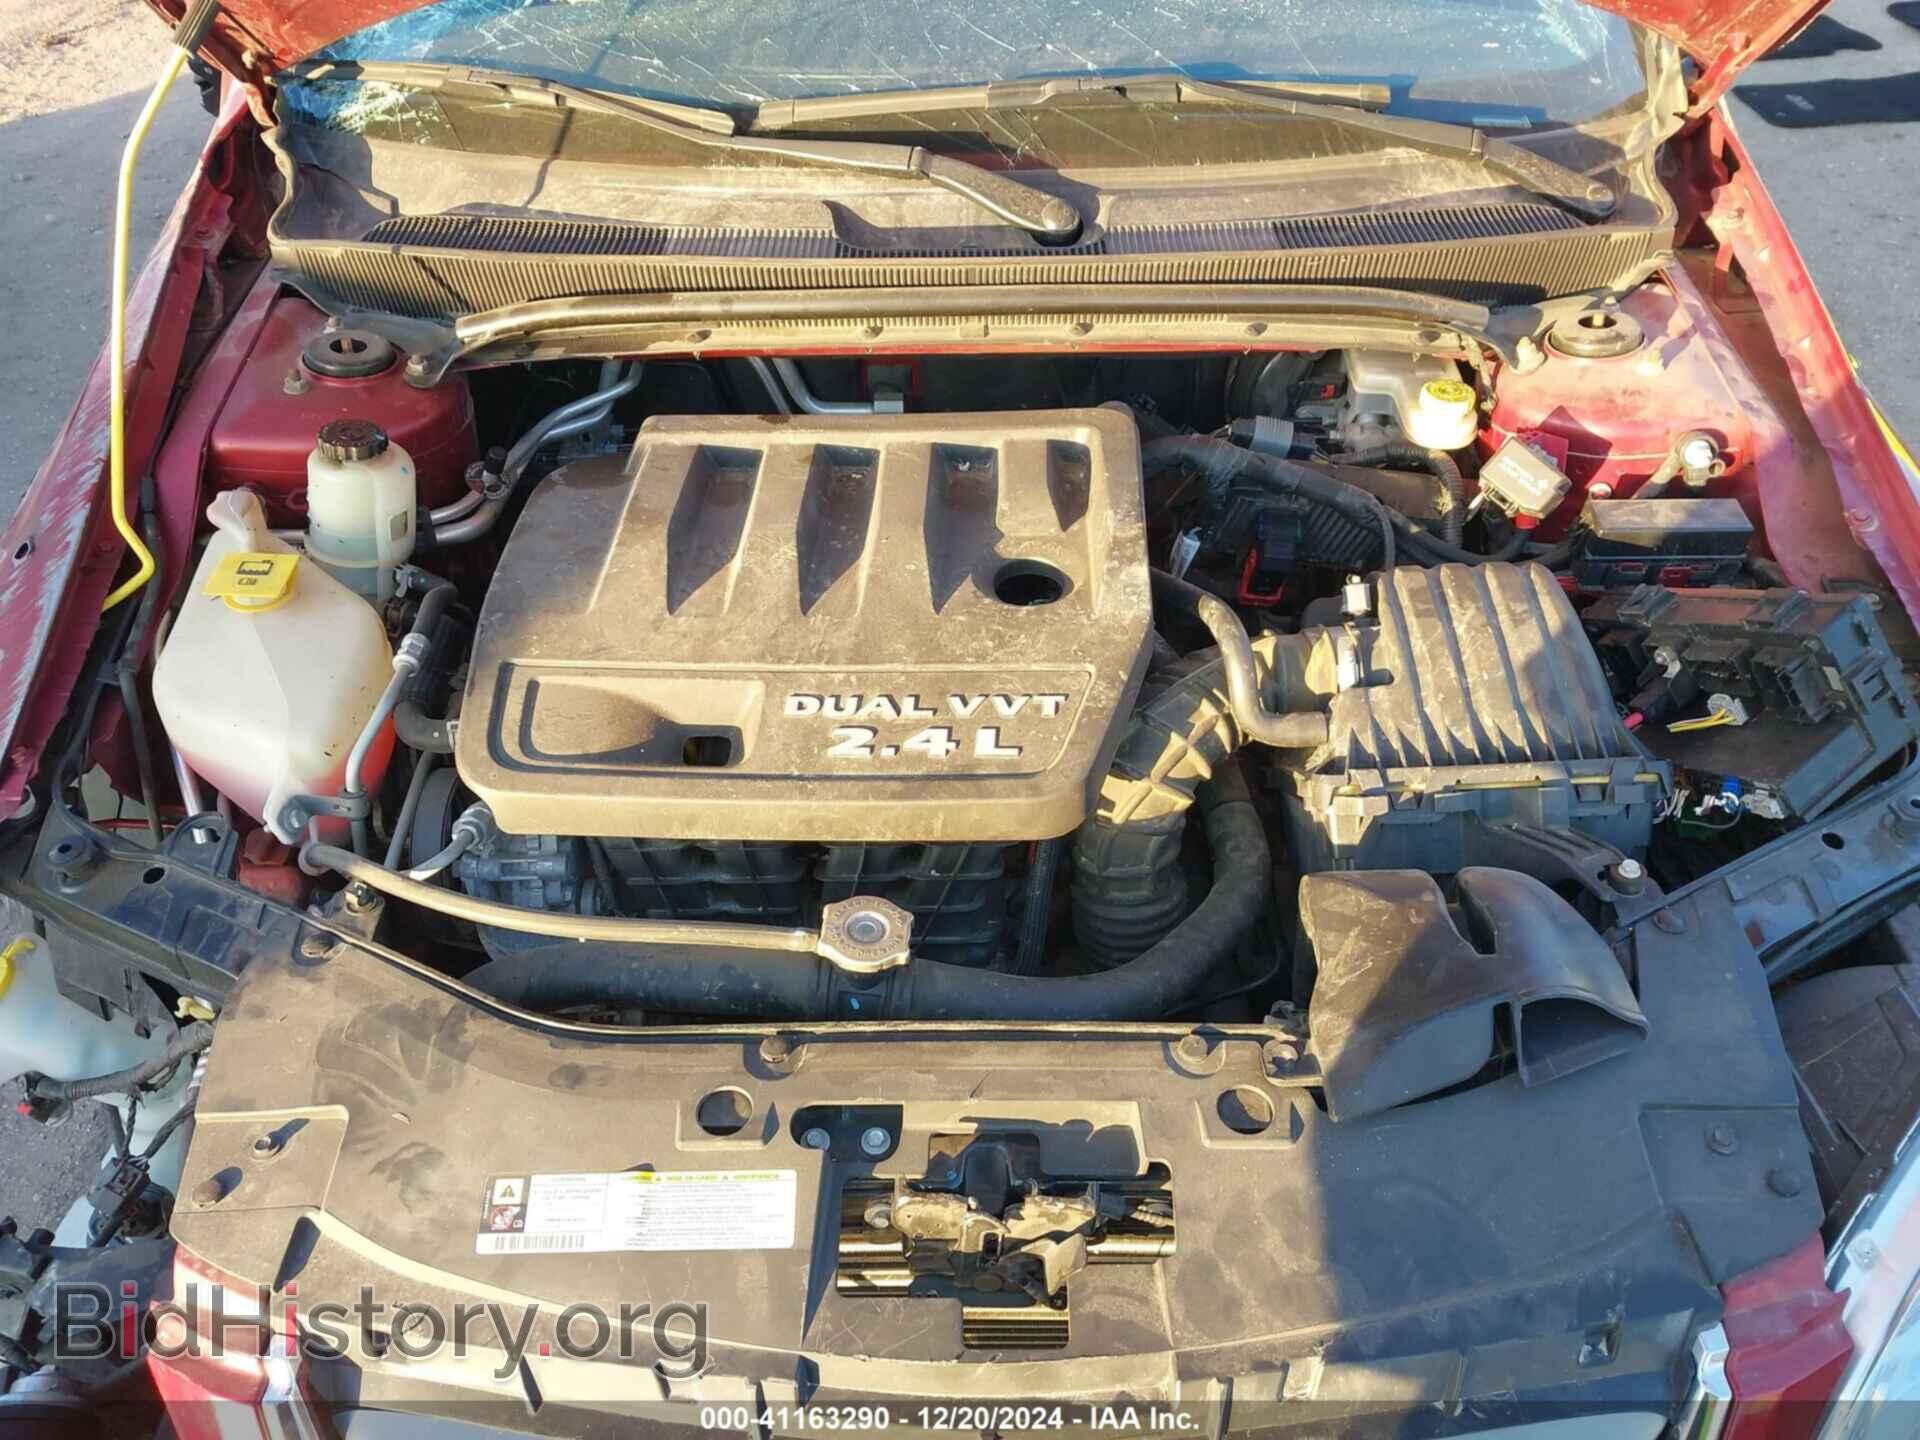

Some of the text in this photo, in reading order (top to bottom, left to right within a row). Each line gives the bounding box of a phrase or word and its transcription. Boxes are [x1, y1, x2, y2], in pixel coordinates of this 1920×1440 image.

[783, 692, 1070, 719] DUAL VVT
[825, 724, 1024, 760] 2.4 L
